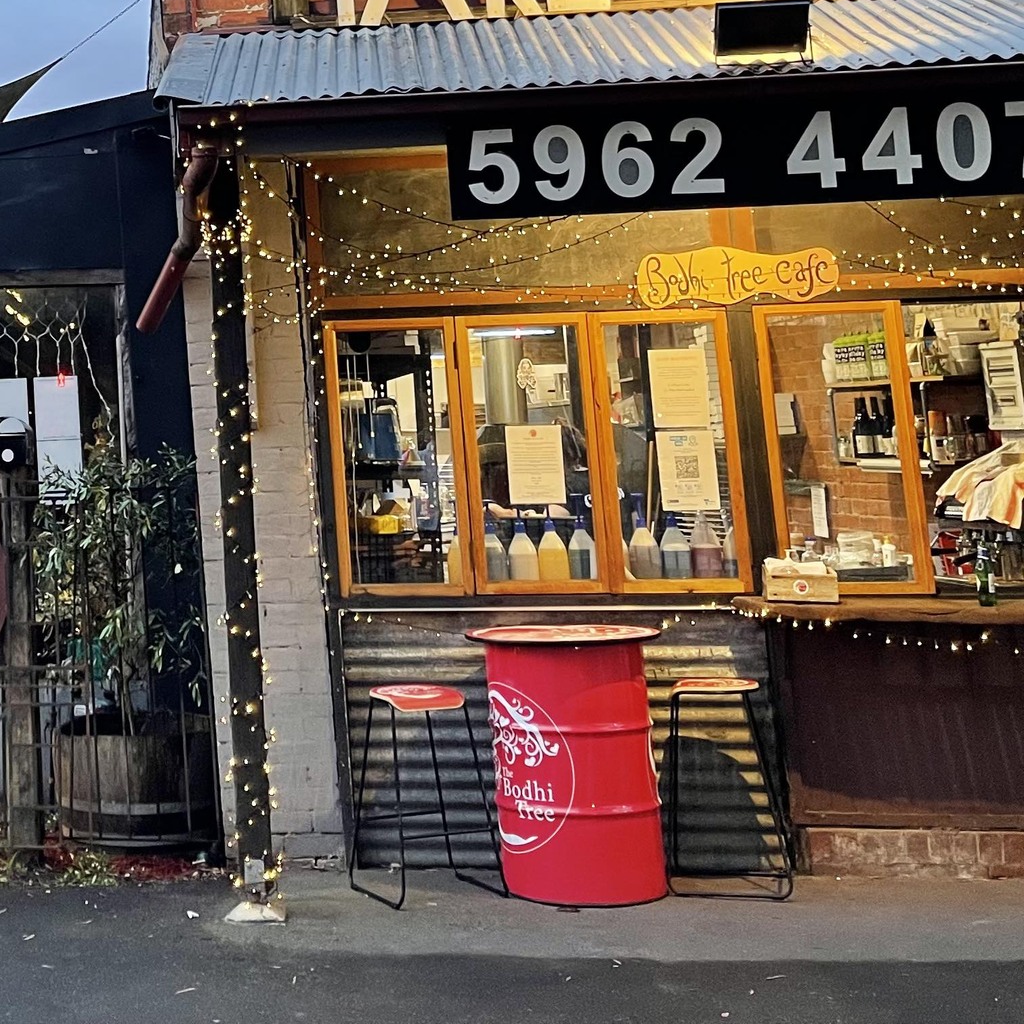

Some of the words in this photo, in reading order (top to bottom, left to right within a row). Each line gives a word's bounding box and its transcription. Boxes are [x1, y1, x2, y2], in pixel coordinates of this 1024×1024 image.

[467, 117, 726, 205] 5962
[645, 252, 710, 305] Bodhi
[503, 778, 554, 802] Bodhi
[515, 800, 555, 822] Tree
